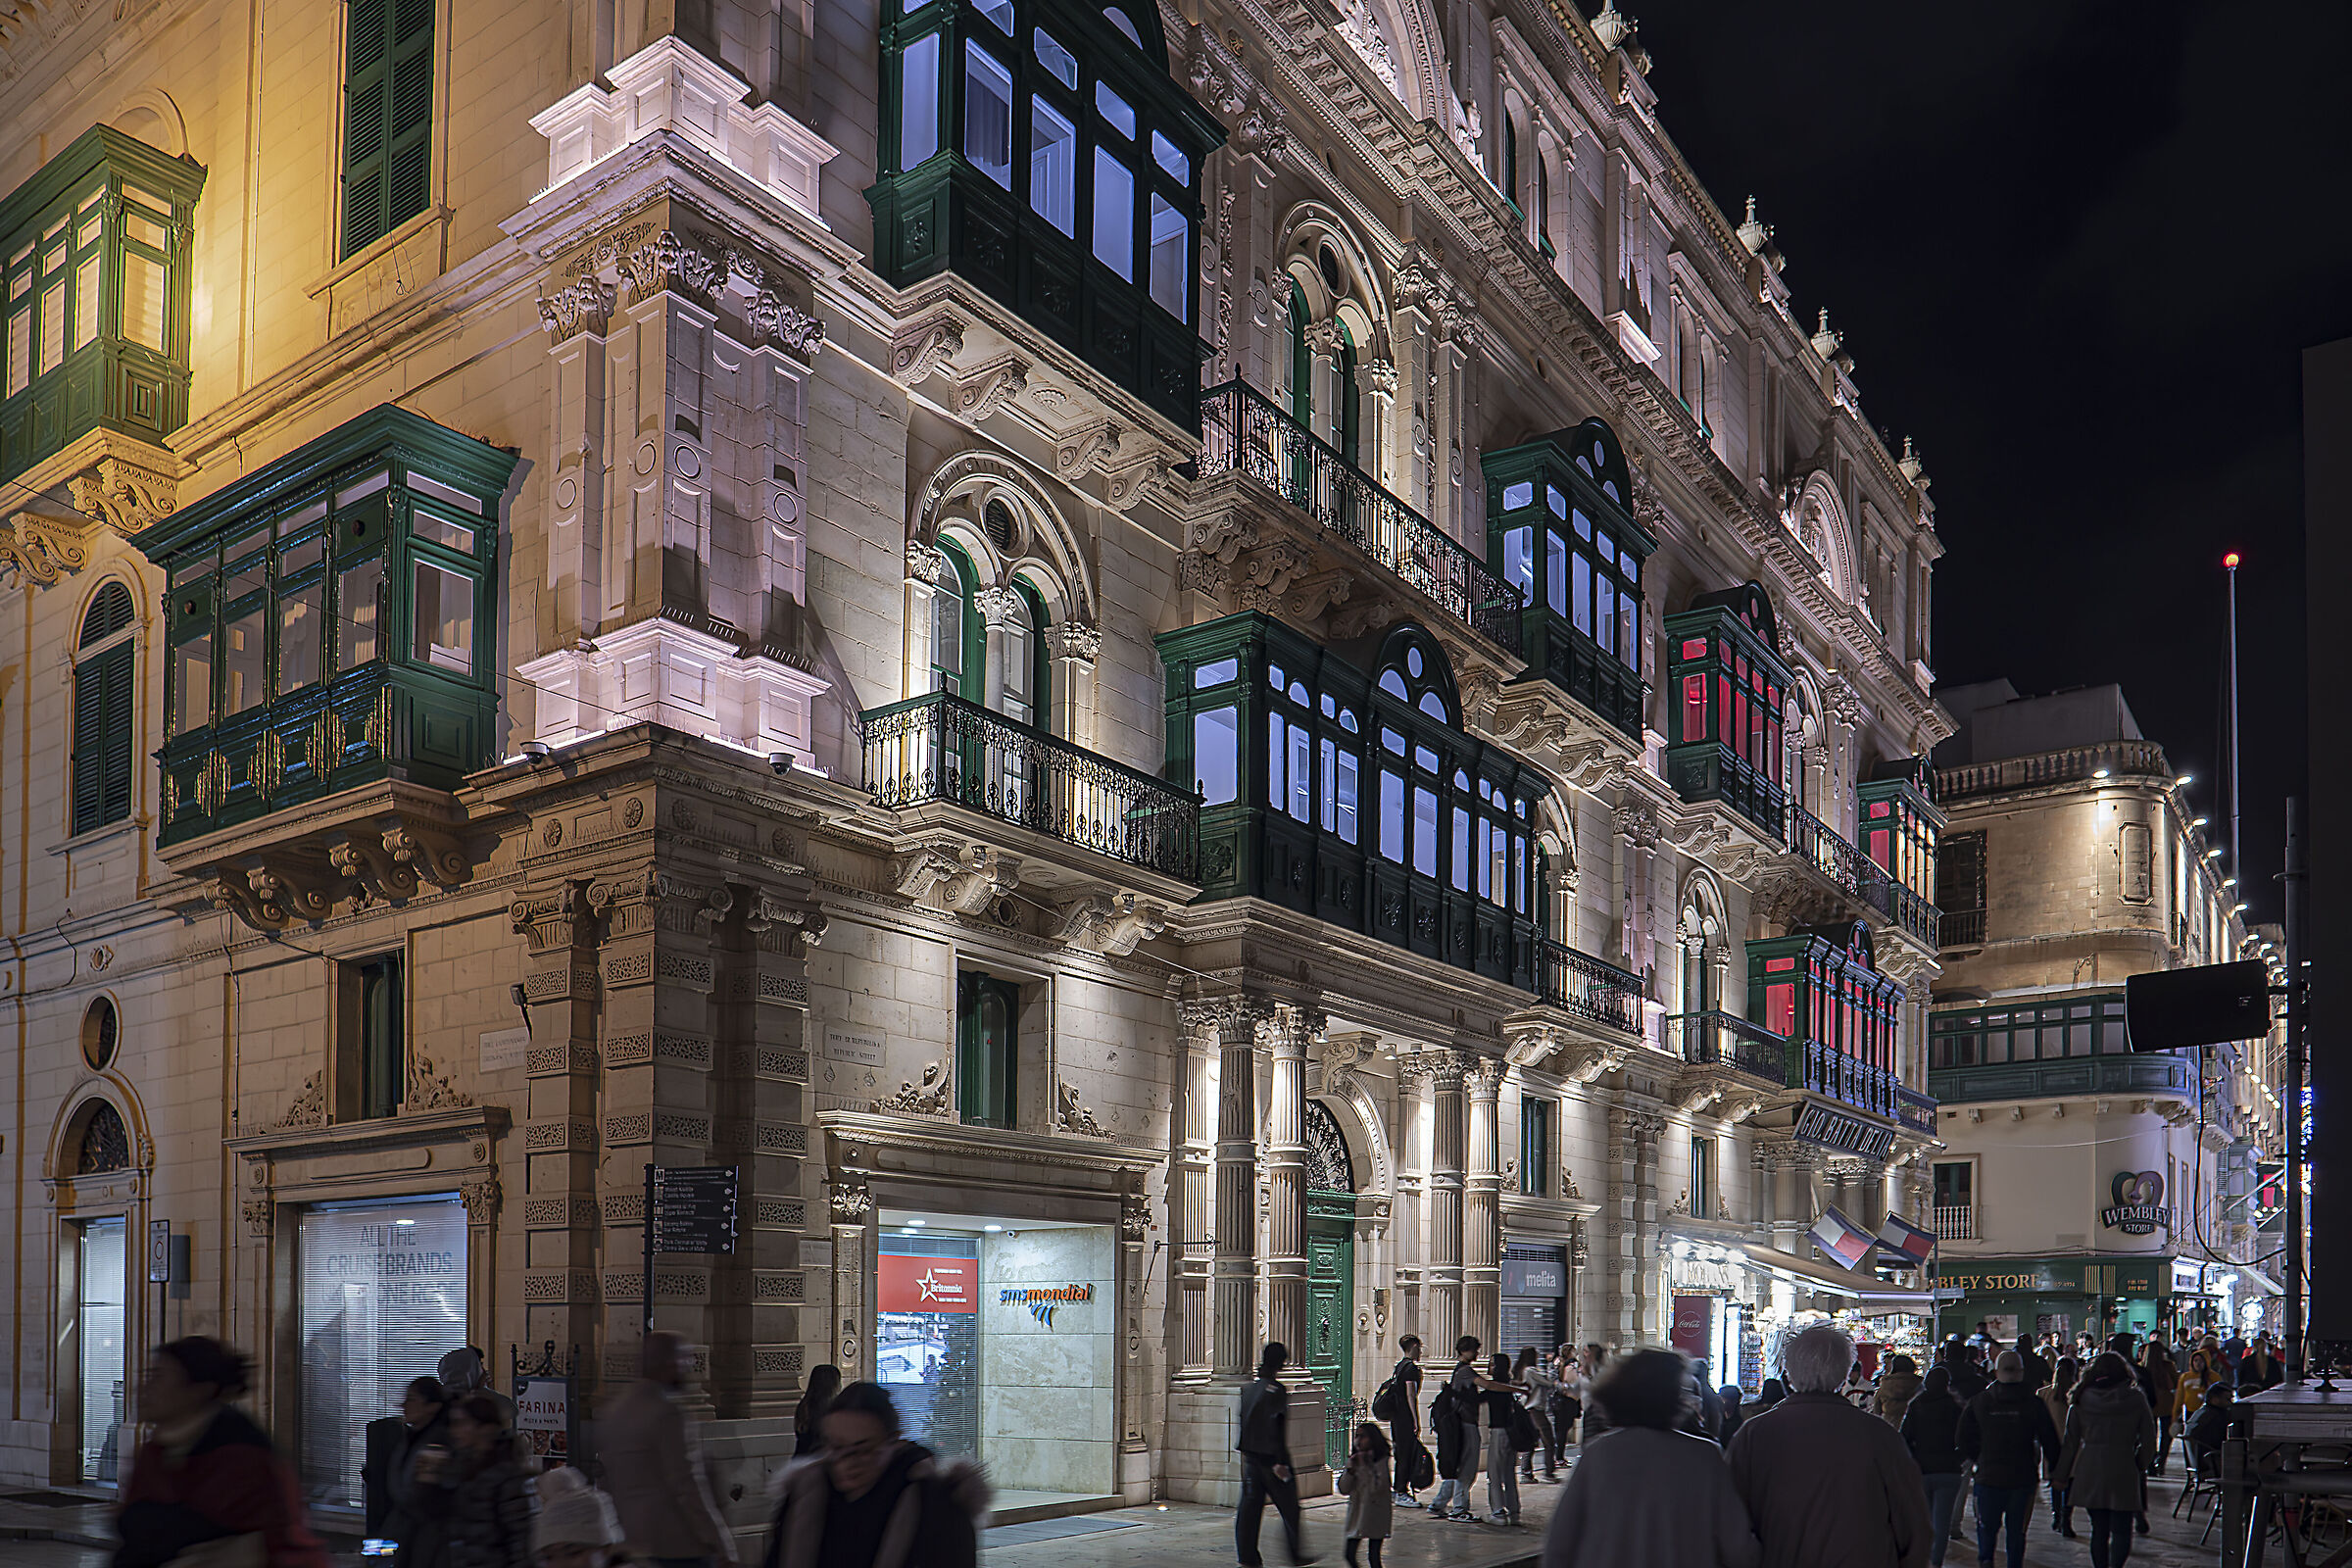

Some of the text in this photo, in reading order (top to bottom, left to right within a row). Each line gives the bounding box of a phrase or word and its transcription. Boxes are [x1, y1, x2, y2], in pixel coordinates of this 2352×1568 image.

[1801, 1108, 1826, 1140] GIO.
[1822, 1115, 1863, 1151] BATTA
[2106, 1206, 2170, 1225] WEMBLEY
[360, 1225, 416, 1248] ALL THE
[2126, 1224, 2151, 1233] STORE
[386, 1251, 453, 1275] BRANDS
[1526, 1270, 1556, 1288] melita
[1985, 1274, 2040, 1290] STORE
[518, 1400, 565, 1414] FARINA
